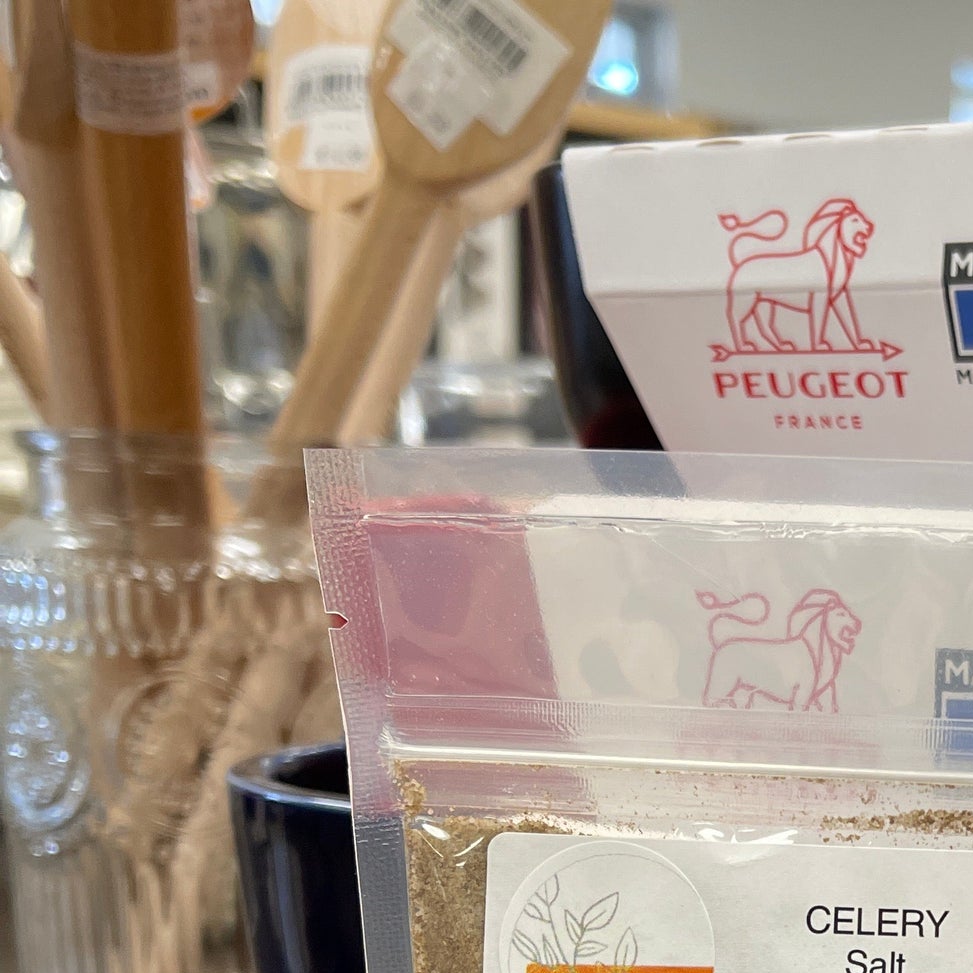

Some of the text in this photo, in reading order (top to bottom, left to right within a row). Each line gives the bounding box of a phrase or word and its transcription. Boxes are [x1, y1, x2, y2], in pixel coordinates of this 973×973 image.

[712, 370, 909, 399] PEUGEOT
[774, 415, 863, 430] FRANCE
[805, 906, 950, 939] CELERY
